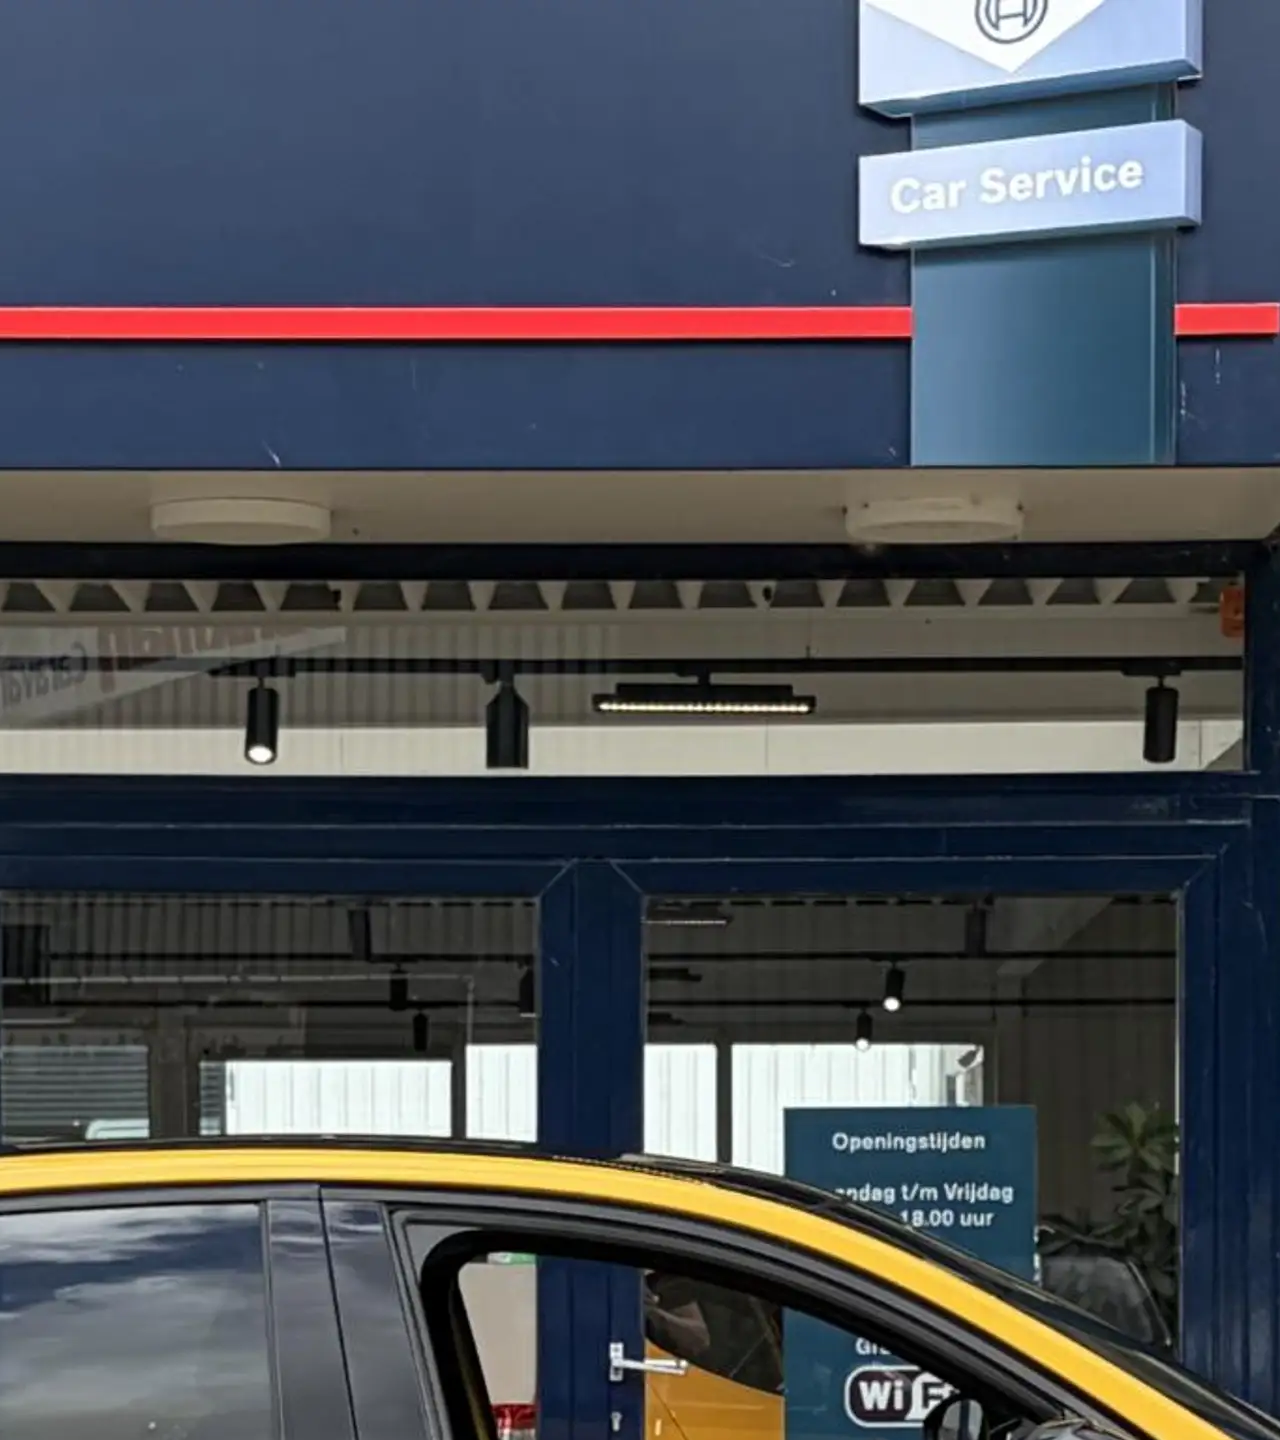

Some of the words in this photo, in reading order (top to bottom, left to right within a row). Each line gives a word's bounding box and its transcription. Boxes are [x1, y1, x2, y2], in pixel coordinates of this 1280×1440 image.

[889, 174, 967, 215] Car
[978, 155, 1144, 206] Service
[832, 1132, 986, 1154] Openingstijden
[900, 1183, 939, 1202] t/m
[943, 1182, 1015, 1205] Vrijdag
[959, 1212, 994, 1227] uur
[858, 1378, 946, 1411] WiF
